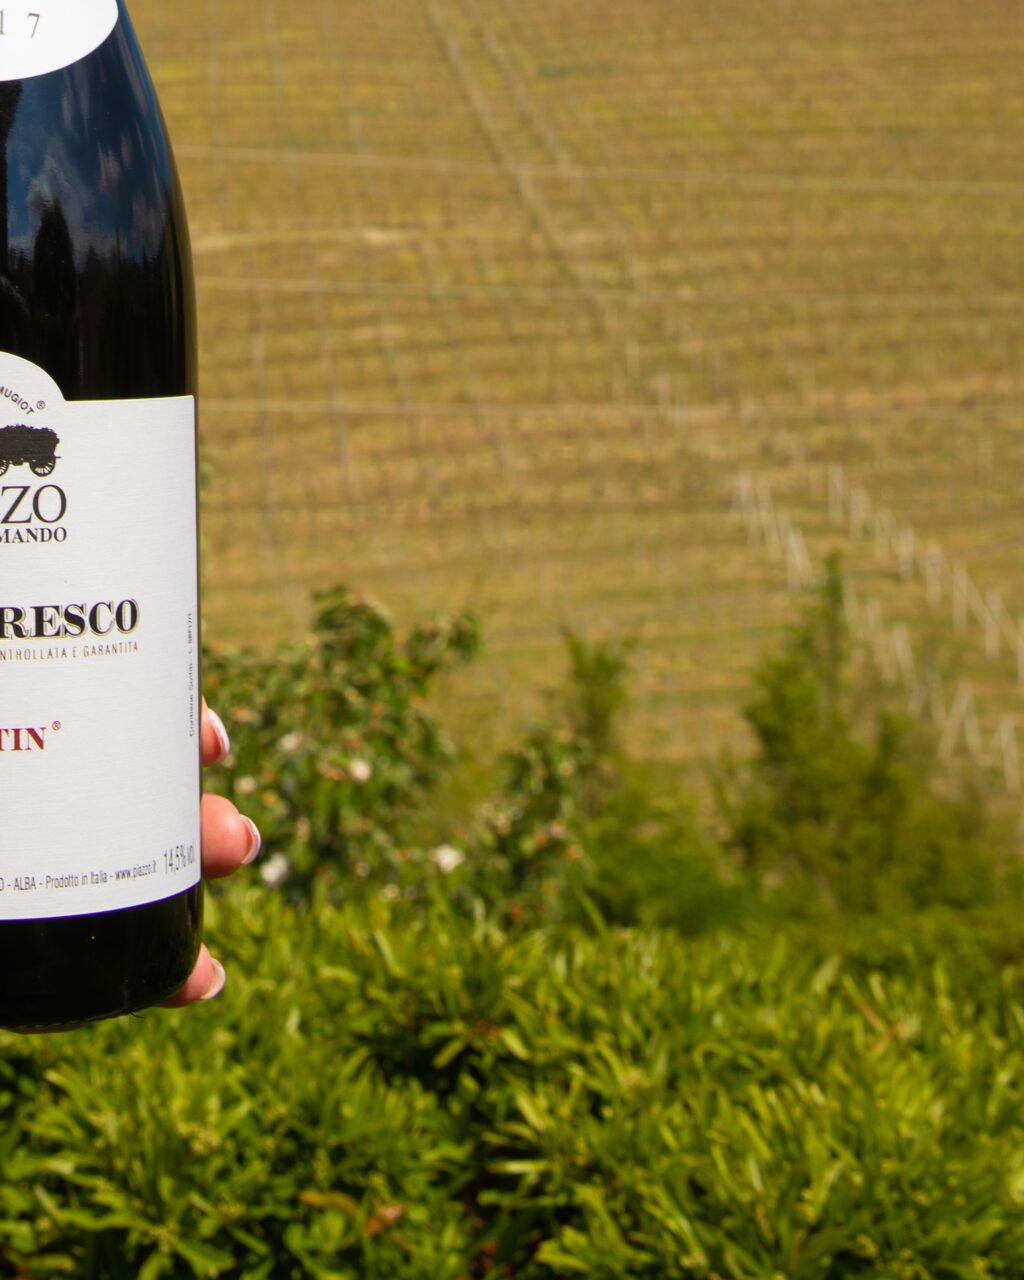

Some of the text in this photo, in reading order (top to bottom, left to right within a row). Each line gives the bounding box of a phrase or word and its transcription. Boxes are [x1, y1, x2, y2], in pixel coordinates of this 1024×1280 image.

[72, 646, 78, 658] E
[83, 641, 139, 659] GARANTITA
[13, 876, 36, 890] ALBA
[45, 875, 79, 888] Prodotto
[81, 872, 88, 885] in
[90, 870, 108, 884] Italia
